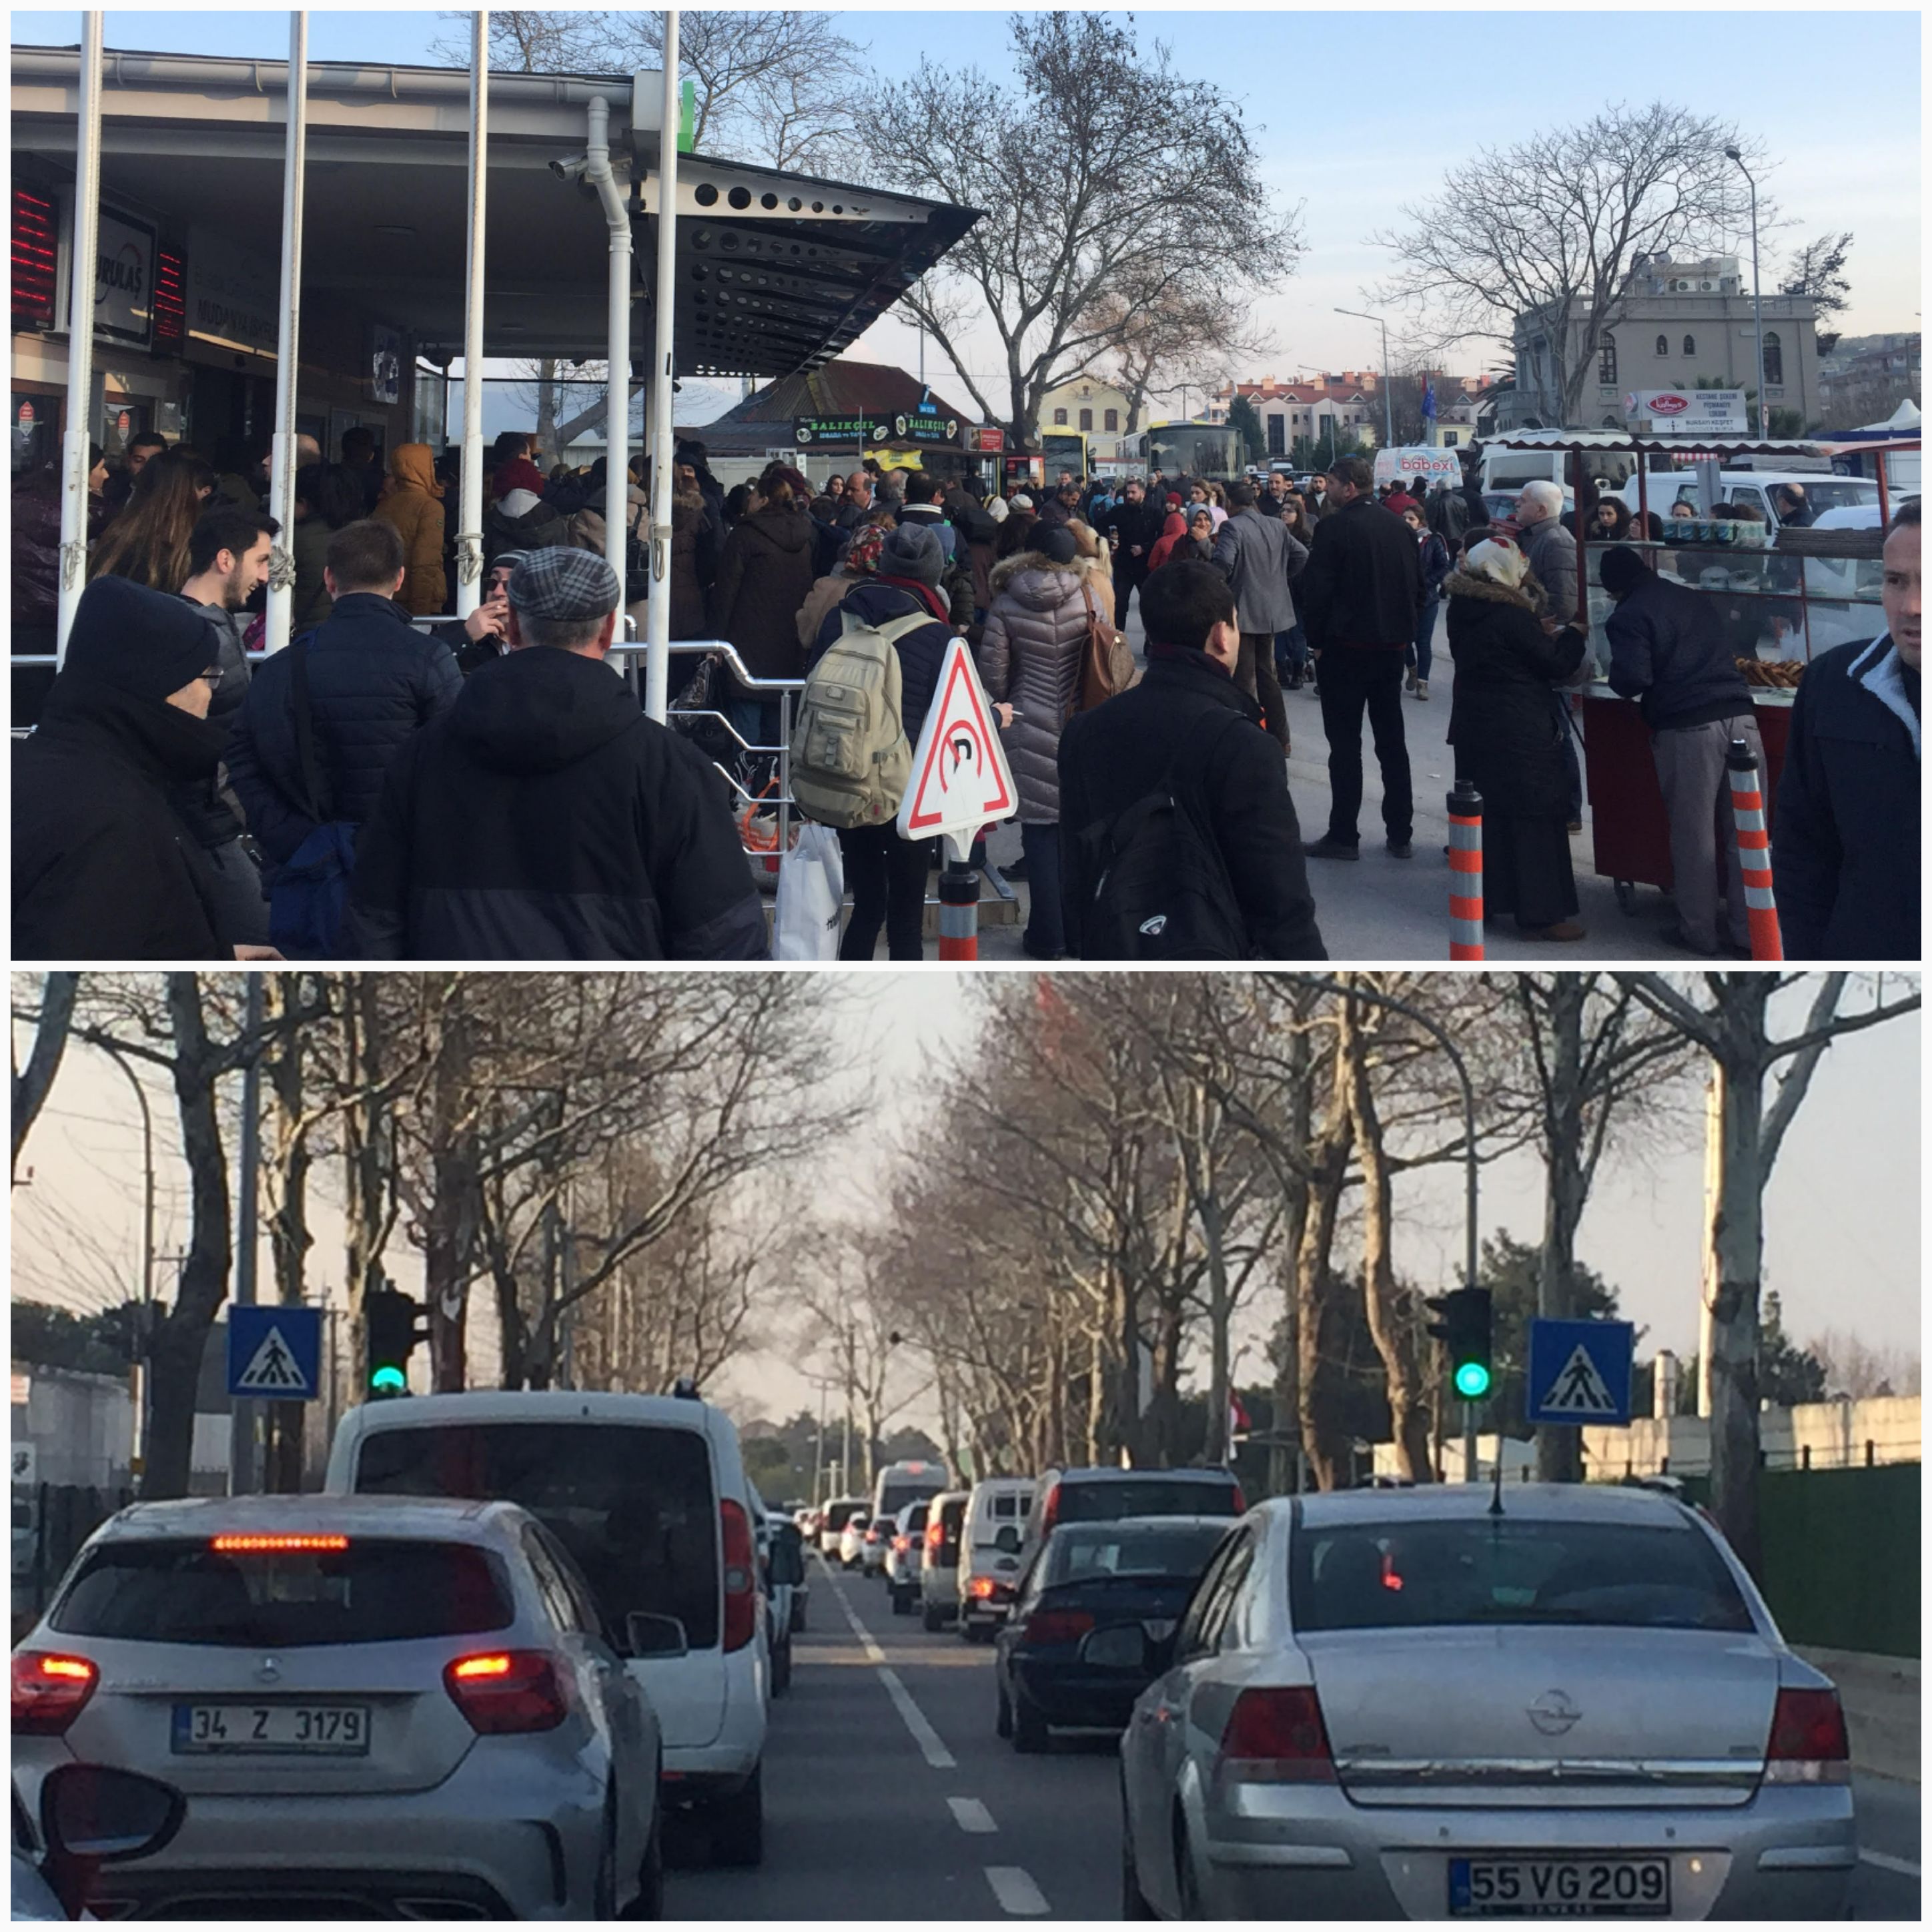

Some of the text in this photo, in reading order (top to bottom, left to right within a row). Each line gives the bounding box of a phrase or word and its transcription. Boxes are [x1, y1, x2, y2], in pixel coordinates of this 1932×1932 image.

[95, 256, 142, 300] URULAŞ
[811, 421, 875, 430] BALIKÇIL
[909, 418, 945, 432] BALIKÇIL
[1401, 457, 1454, 470] babexi
[195, 1710, 360, 1740] 34 Z 3179
[1472, 1865, 1662, 1900] 55 VG 209
